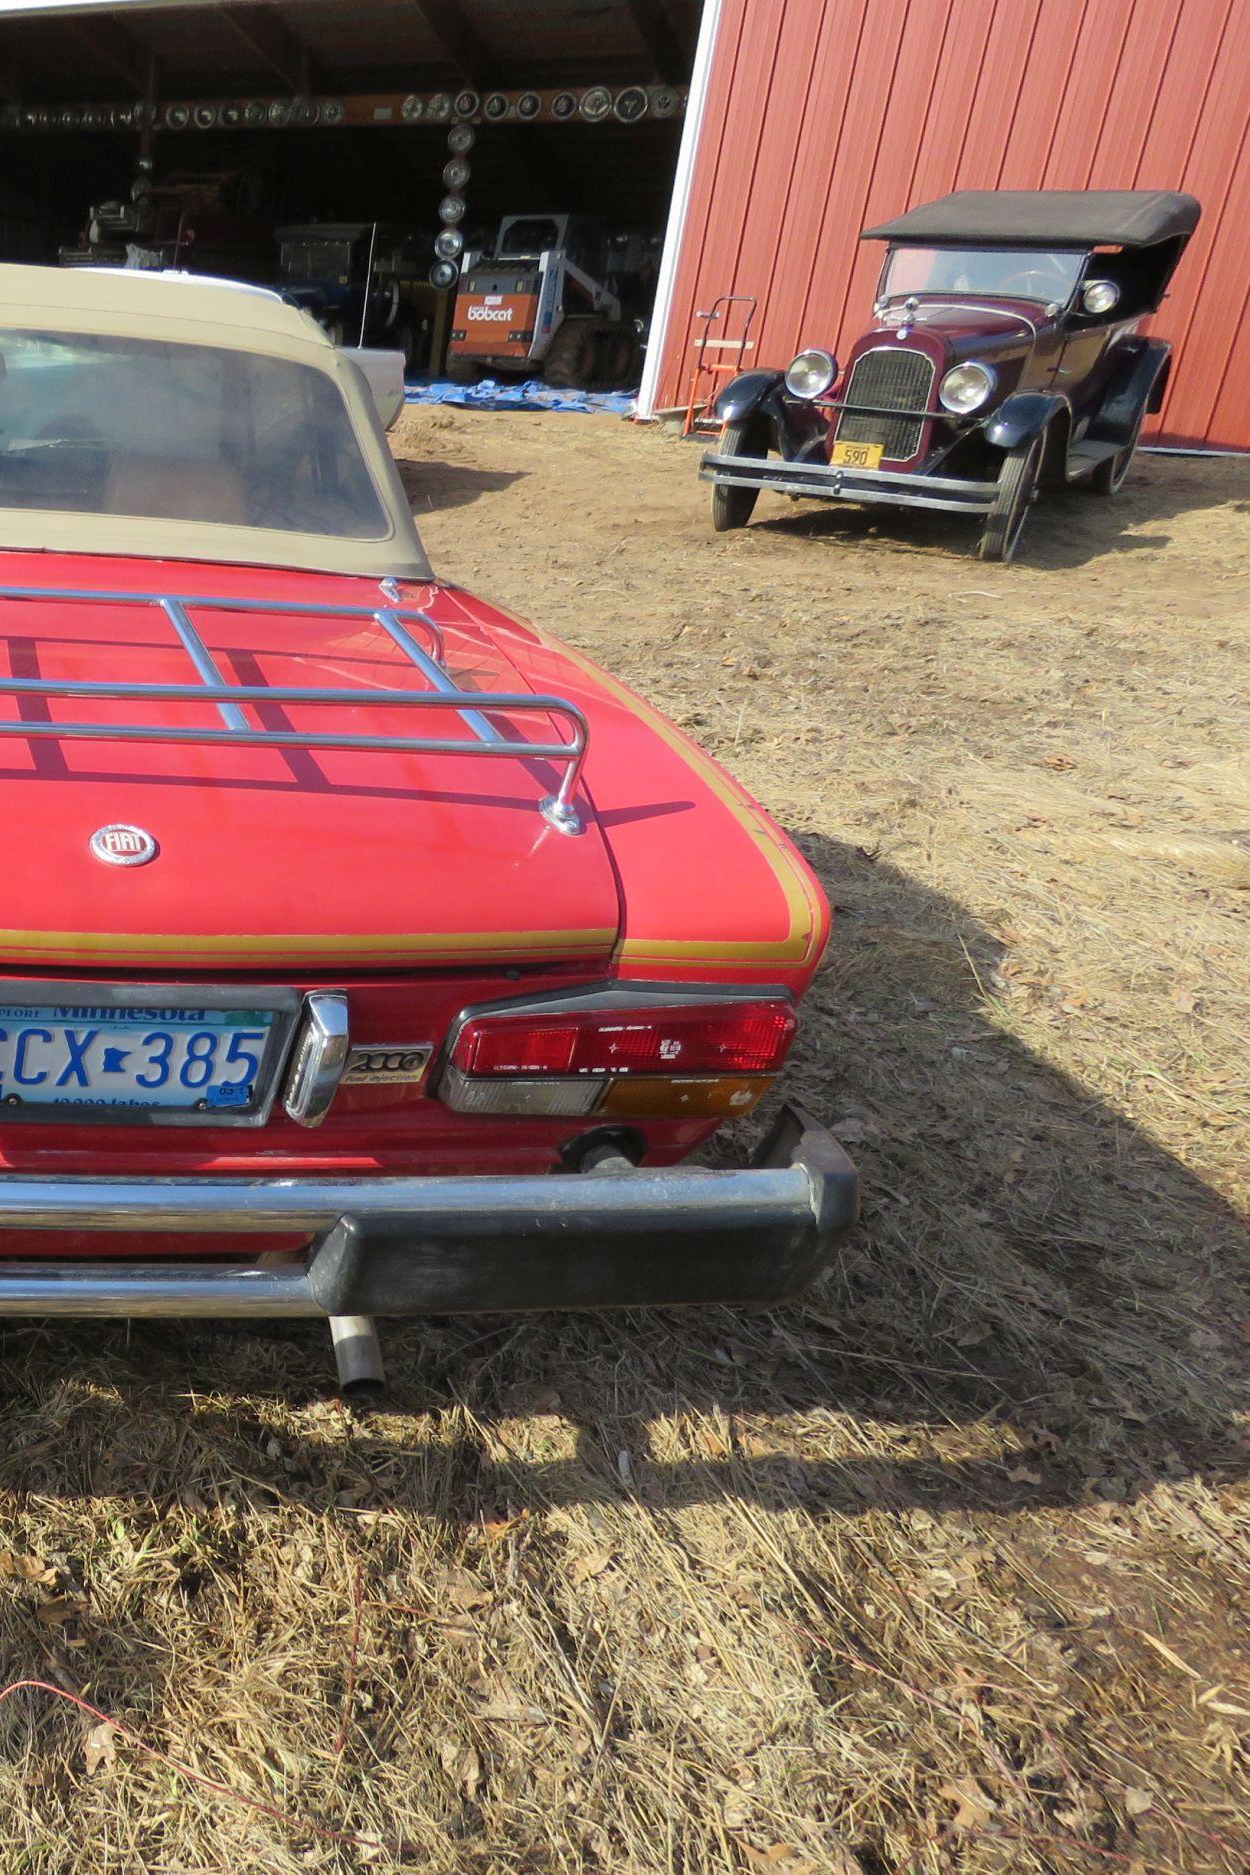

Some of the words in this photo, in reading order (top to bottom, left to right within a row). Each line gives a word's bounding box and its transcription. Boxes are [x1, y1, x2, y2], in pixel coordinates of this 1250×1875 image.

[467, 305, 513, 321] bobcat
[843, 449, 869, 466] 590
[104, 831, 142, 851] FIAT
[53, 1006, 206, 1021] Minnesota
[135, 1031, 264, 1088] 385
[348, 1051, 424, 1071] 2000
